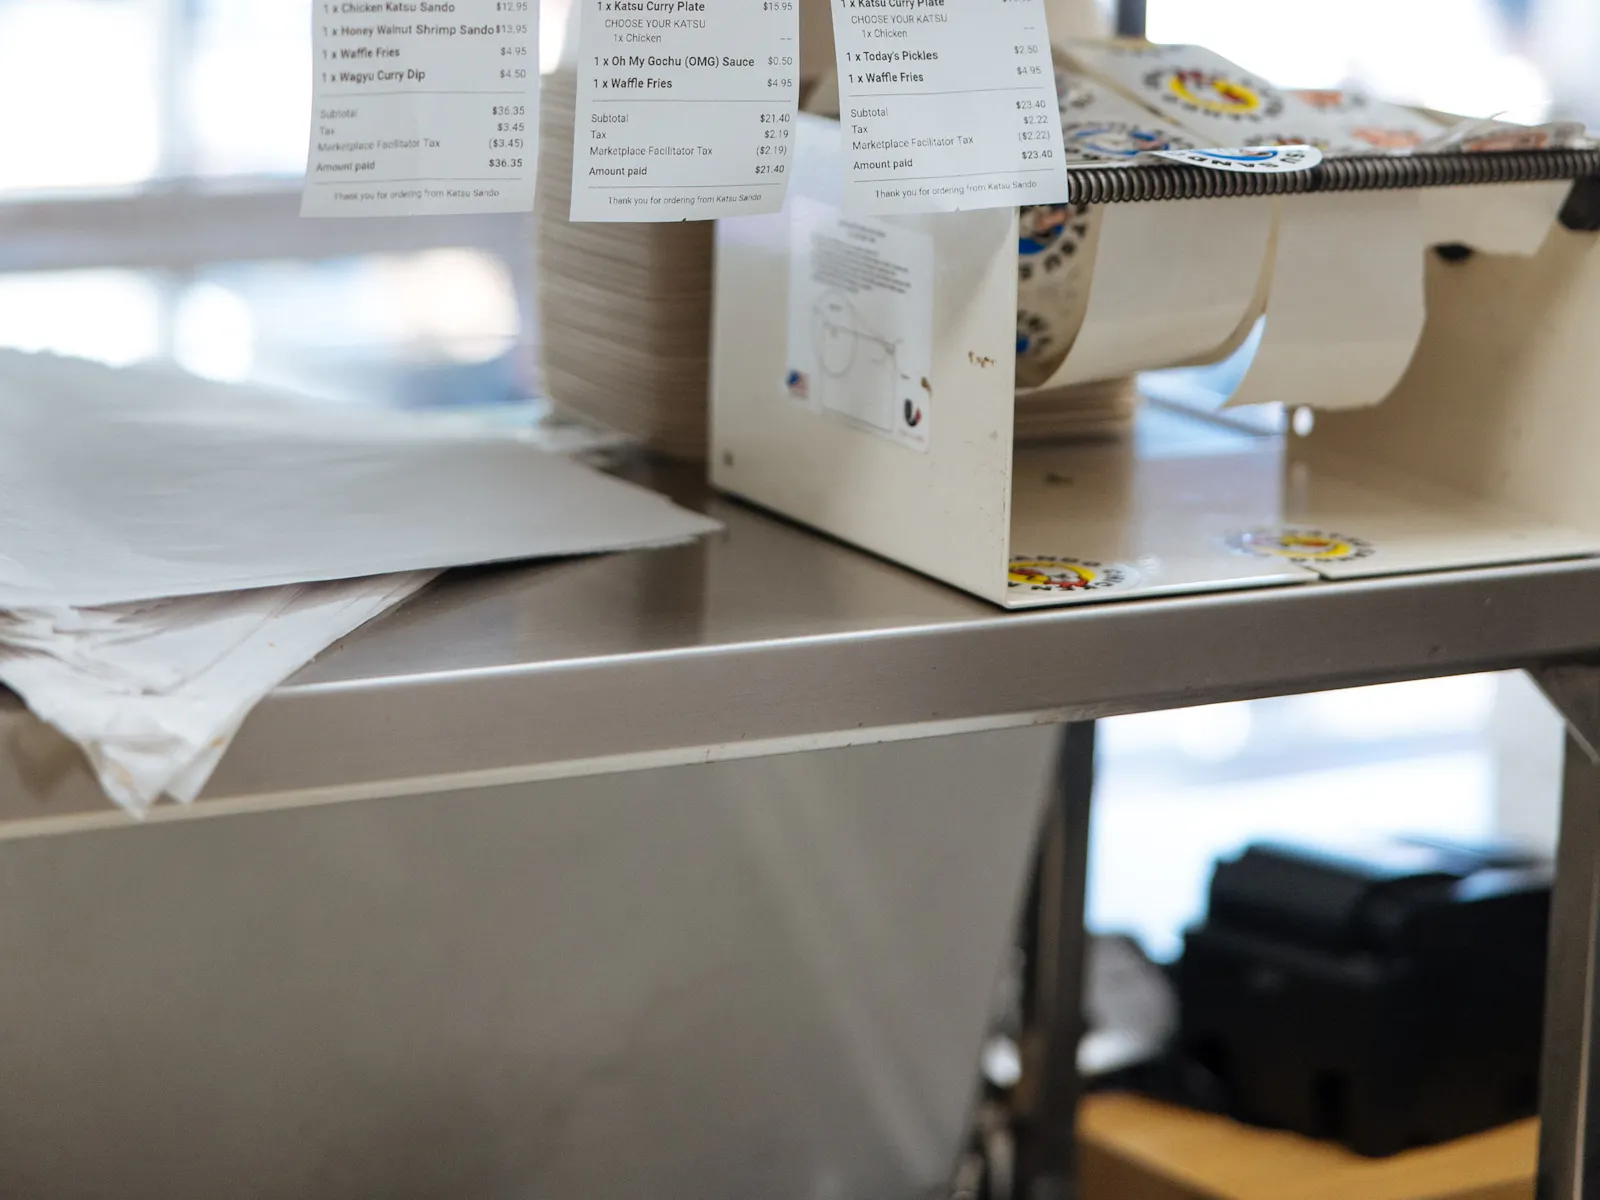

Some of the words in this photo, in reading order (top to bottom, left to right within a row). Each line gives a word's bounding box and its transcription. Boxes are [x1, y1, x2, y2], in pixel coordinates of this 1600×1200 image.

[342, 3, 383, 12] Chicken
[386, 3, 416, 11] Katsu
[420, 2, 455, 11] Sando
[614, 2, 643, 11] Katsu
[646, 2, 674, 13] Curry
[678, 2, 705, 11] Plate
[763, 2, 792, 11] $15.95
[605, 19, 643, 28] CHOOSE
[646, 20, 671, 28] YOUR
[674, 20, 706, 28] KATSU
[851, 15, 889, 24] CHOOSE
[891, 15, 914, 23] YOUR
[916, 14, 947, 23] KATSU
[342, 26, 373, 37] Honey
[377, 26, 412, 35] Walnut
[416, 25, 456, 36] Shrimp
[460, 25, 494, 35] Sando
[874, 29, 907, 38] Chicken
[614, 34, 623, 42] 1x
[626, 34, 662, 42] Chicken
[341, 49, 372, 58] Waffle
[376, 48, 400, 57] Fries
[863, 51, 900, 63] Today's
[902, 50, 938, 60] Pickles
[612, 57, 626, 66] Oh
[629, 57, 645, 69] My
[648, 57, 681, 66] Gochu
[685, 56, 719, 68] (OMG)
[722, 57, 755, 67] Sauce
[767, 56, 792, 66] $0.50
[340, 72, 374, 84] Wagyu
[377, 70, 404, 82] Curry
[407, 69, 425, 81] Dip
[866, 73, 897, 83] Waffle
[900, 73, 923, 82] Fries
[611, 78, 644, 88] Waffle
[647, 79, 672, 88] Fries
[767, 79, 792, 87] $4.95
[851, 108, 888, 118] Subtotal
[1016, 100, 1046, 109] $23.40
[591, 114, 628, 123] Subtotal
[760, 114, 790, 123] $21.40
[852, 125, 868, 134] Tax
[1023, 116, 1048, 125] $2.22
[591, 131, 606, 139] Tax
[764, 130, 788, 139] $2.19
[590, 147, 646, 157] Marketplace
[649, 146, 694, 156] Facilitator
[698, 147, 712, 155] Tax
[316, 163, 352, 172] Amount
[355, 161, 375, 172] paid
[489, 159, 522, 168] $36.35
[854, 160, 890, 170] Amount
[893, 159, 913, 169] paid
[1021, 150, 1052, 159] $23.40
[589, 167, 625, 176] Amount
[628, 167, 647, 177] paid
[755, 165, 784, 174] $21.40
